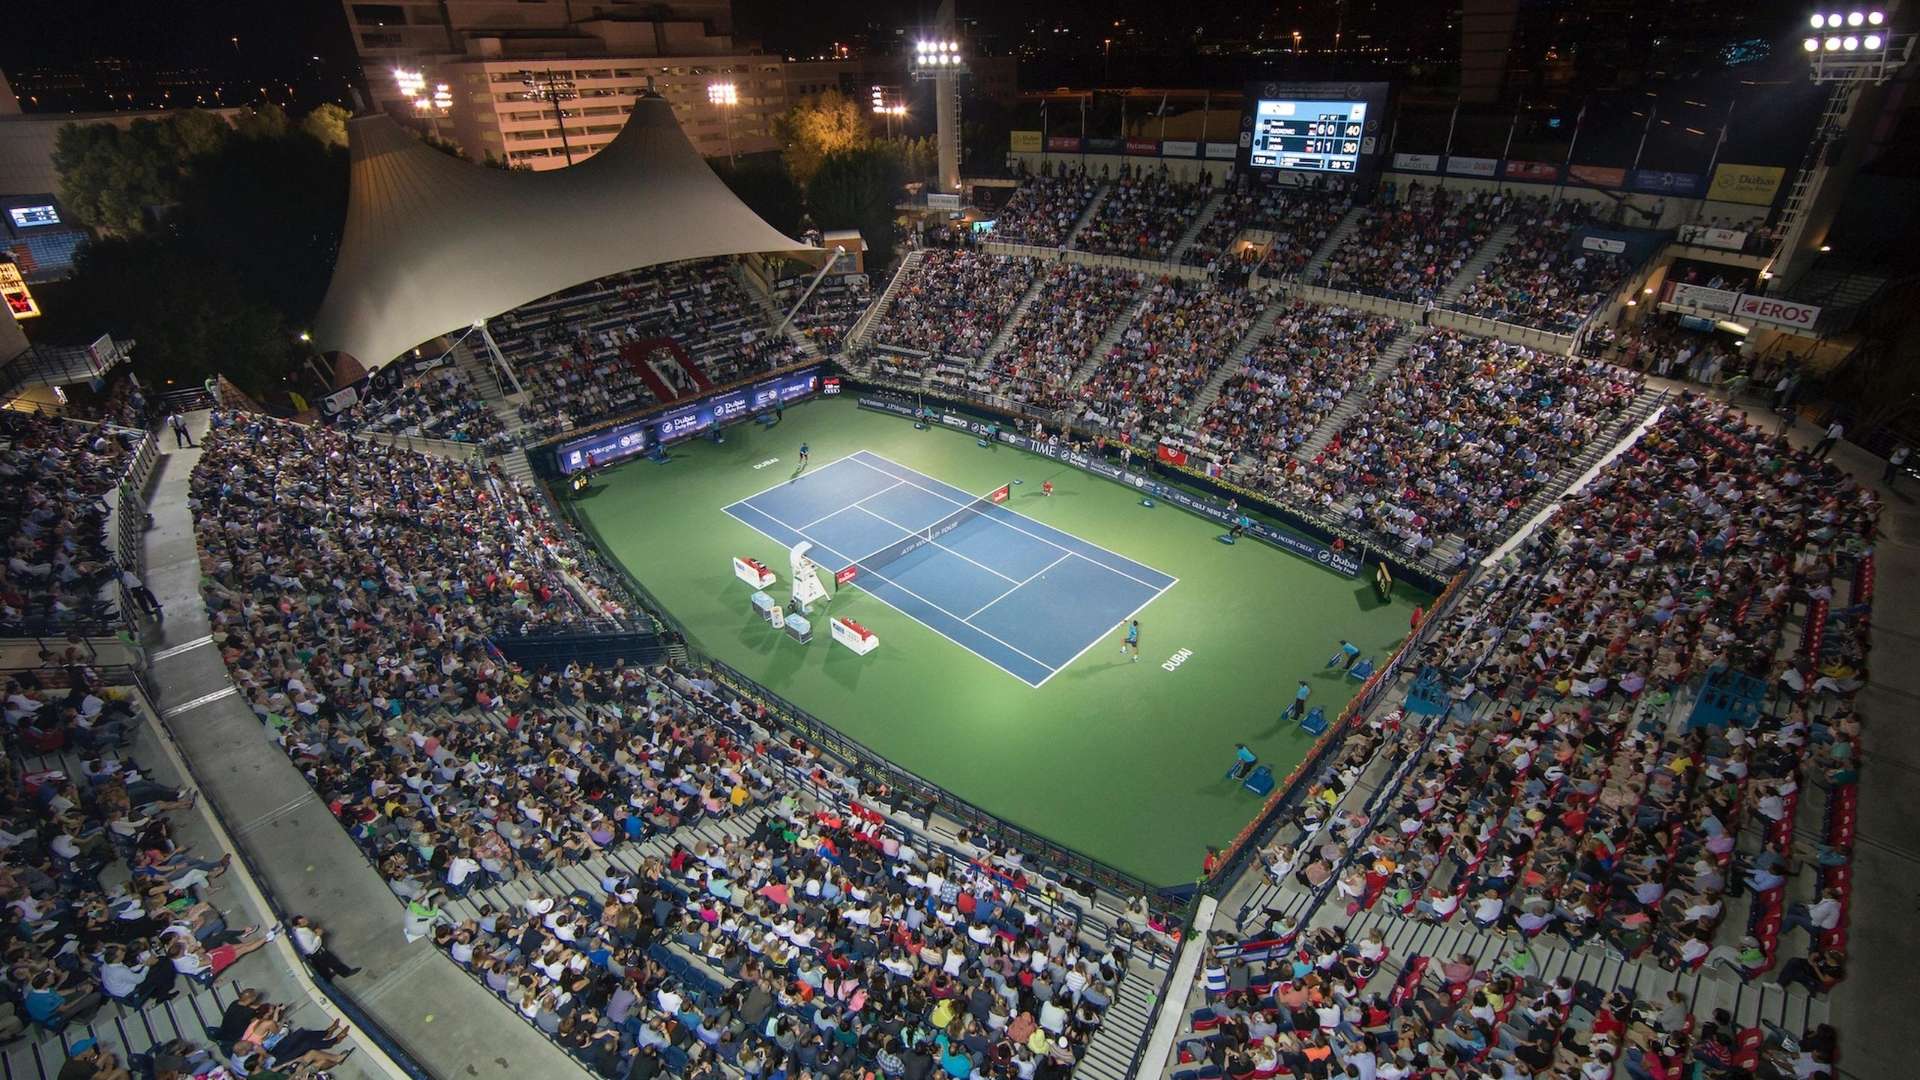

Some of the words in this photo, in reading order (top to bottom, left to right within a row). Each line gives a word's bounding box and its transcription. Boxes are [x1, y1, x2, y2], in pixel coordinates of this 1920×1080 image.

[1318, 124, 1325, 135] 6
[1327, 124, 1335, 135] 0
[1346, 126, 1360, 136] 40
[1343, 142, 1357, 153] 30
[1399, 161, 1430, 169] LACOSTE
[1759, 301, 1812, 323] EROS
[725, 399, 746, 409] Dubai
[674, 415, 696, 426] Dubai
[1029, 439, 1058, 457] TIME
[1070, 451, 1088, 464] Dubai
[1332, 554, 1358, 570] Dubai
[1161, 647, 1193, 672] DUBAI
